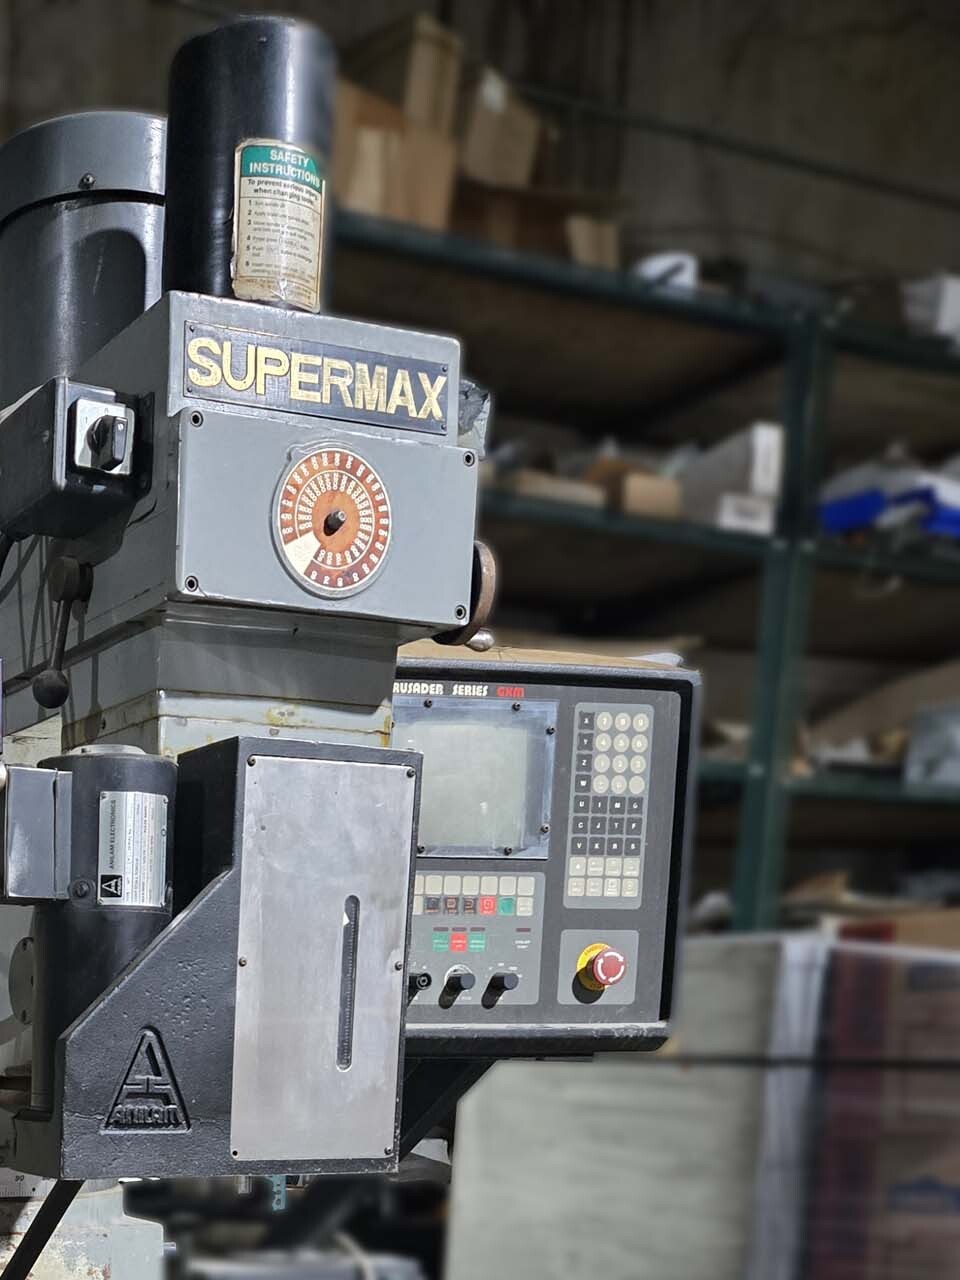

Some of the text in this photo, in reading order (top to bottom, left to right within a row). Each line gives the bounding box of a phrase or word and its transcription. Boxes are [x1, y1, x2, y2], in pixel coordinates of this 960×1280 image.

[270, 149, 309, 167] SAFETY
[249, 161, 320, 188] INSTRUCTIONS
[256, 179, 282, 187] prevent
[186, 336, 448, 421] SUPERMAX
[392, 681, 444, 695] RUSADER
[452, 684, 489, 697] SERIES
[14, 1174, 25, 1182] 90
